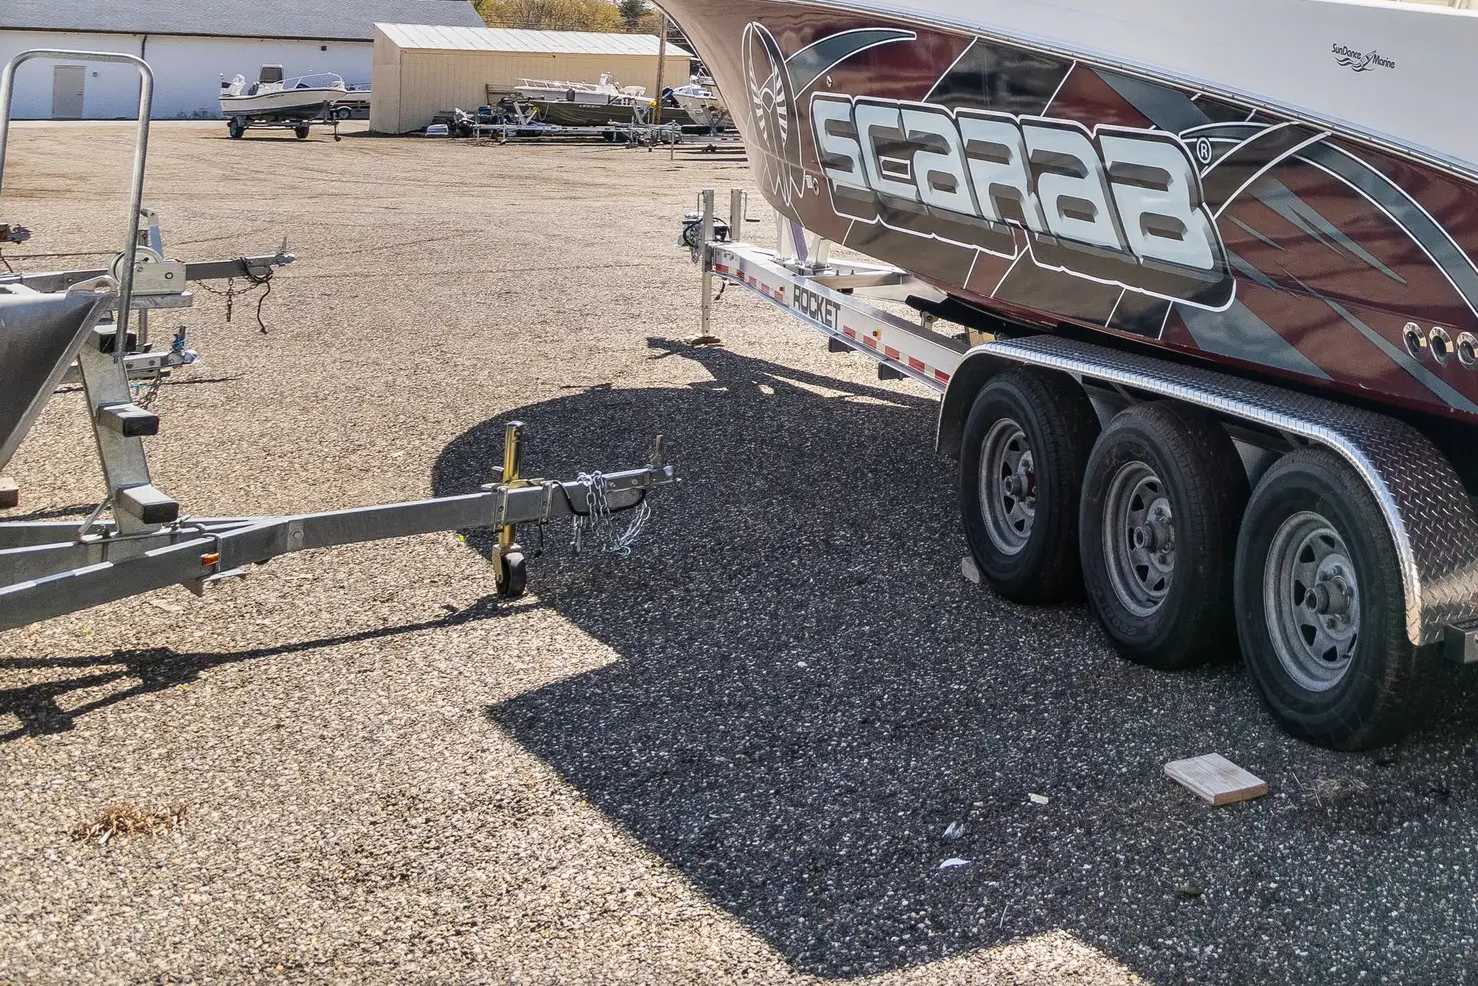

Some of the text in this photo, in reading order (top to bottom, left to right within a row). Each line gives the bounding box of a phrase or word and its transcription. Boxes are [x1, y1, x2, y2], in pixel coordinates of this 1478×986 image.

[1331, 43, 1396, 69] SunDance Marine
[793, 283, 841, 331] ROCKET
